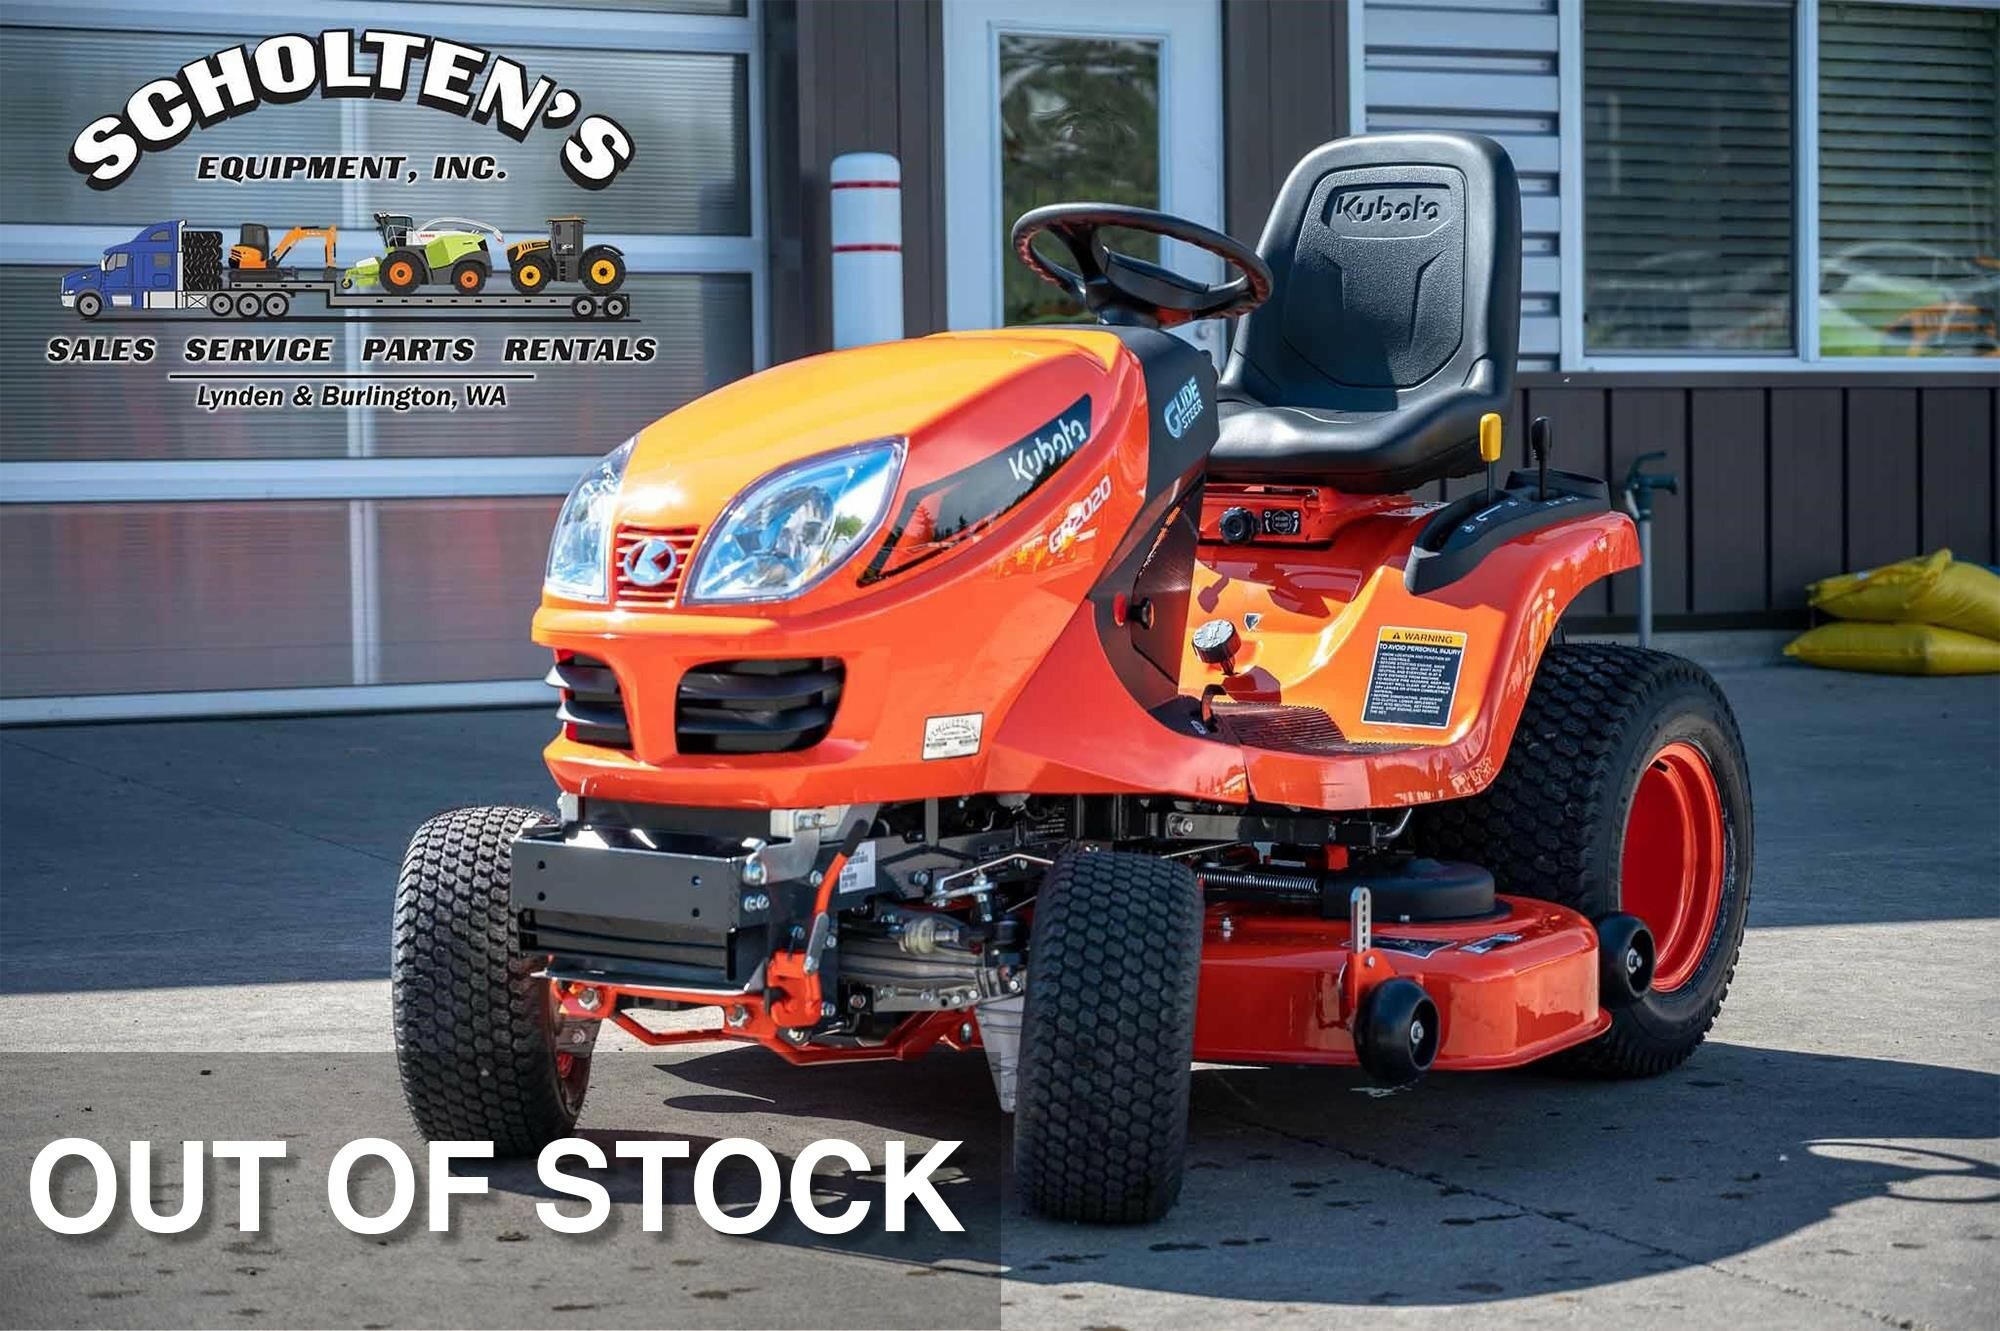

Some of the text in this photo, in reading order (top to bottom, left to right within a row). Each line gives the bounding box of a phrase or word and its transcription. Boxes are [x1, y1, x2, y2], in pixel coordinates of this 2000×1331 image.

[1336, 194, 1441, 222] Kubota
[1008, 417, 1087, 482] Kubota
[1405, 632, 1453, 644] WARNING
